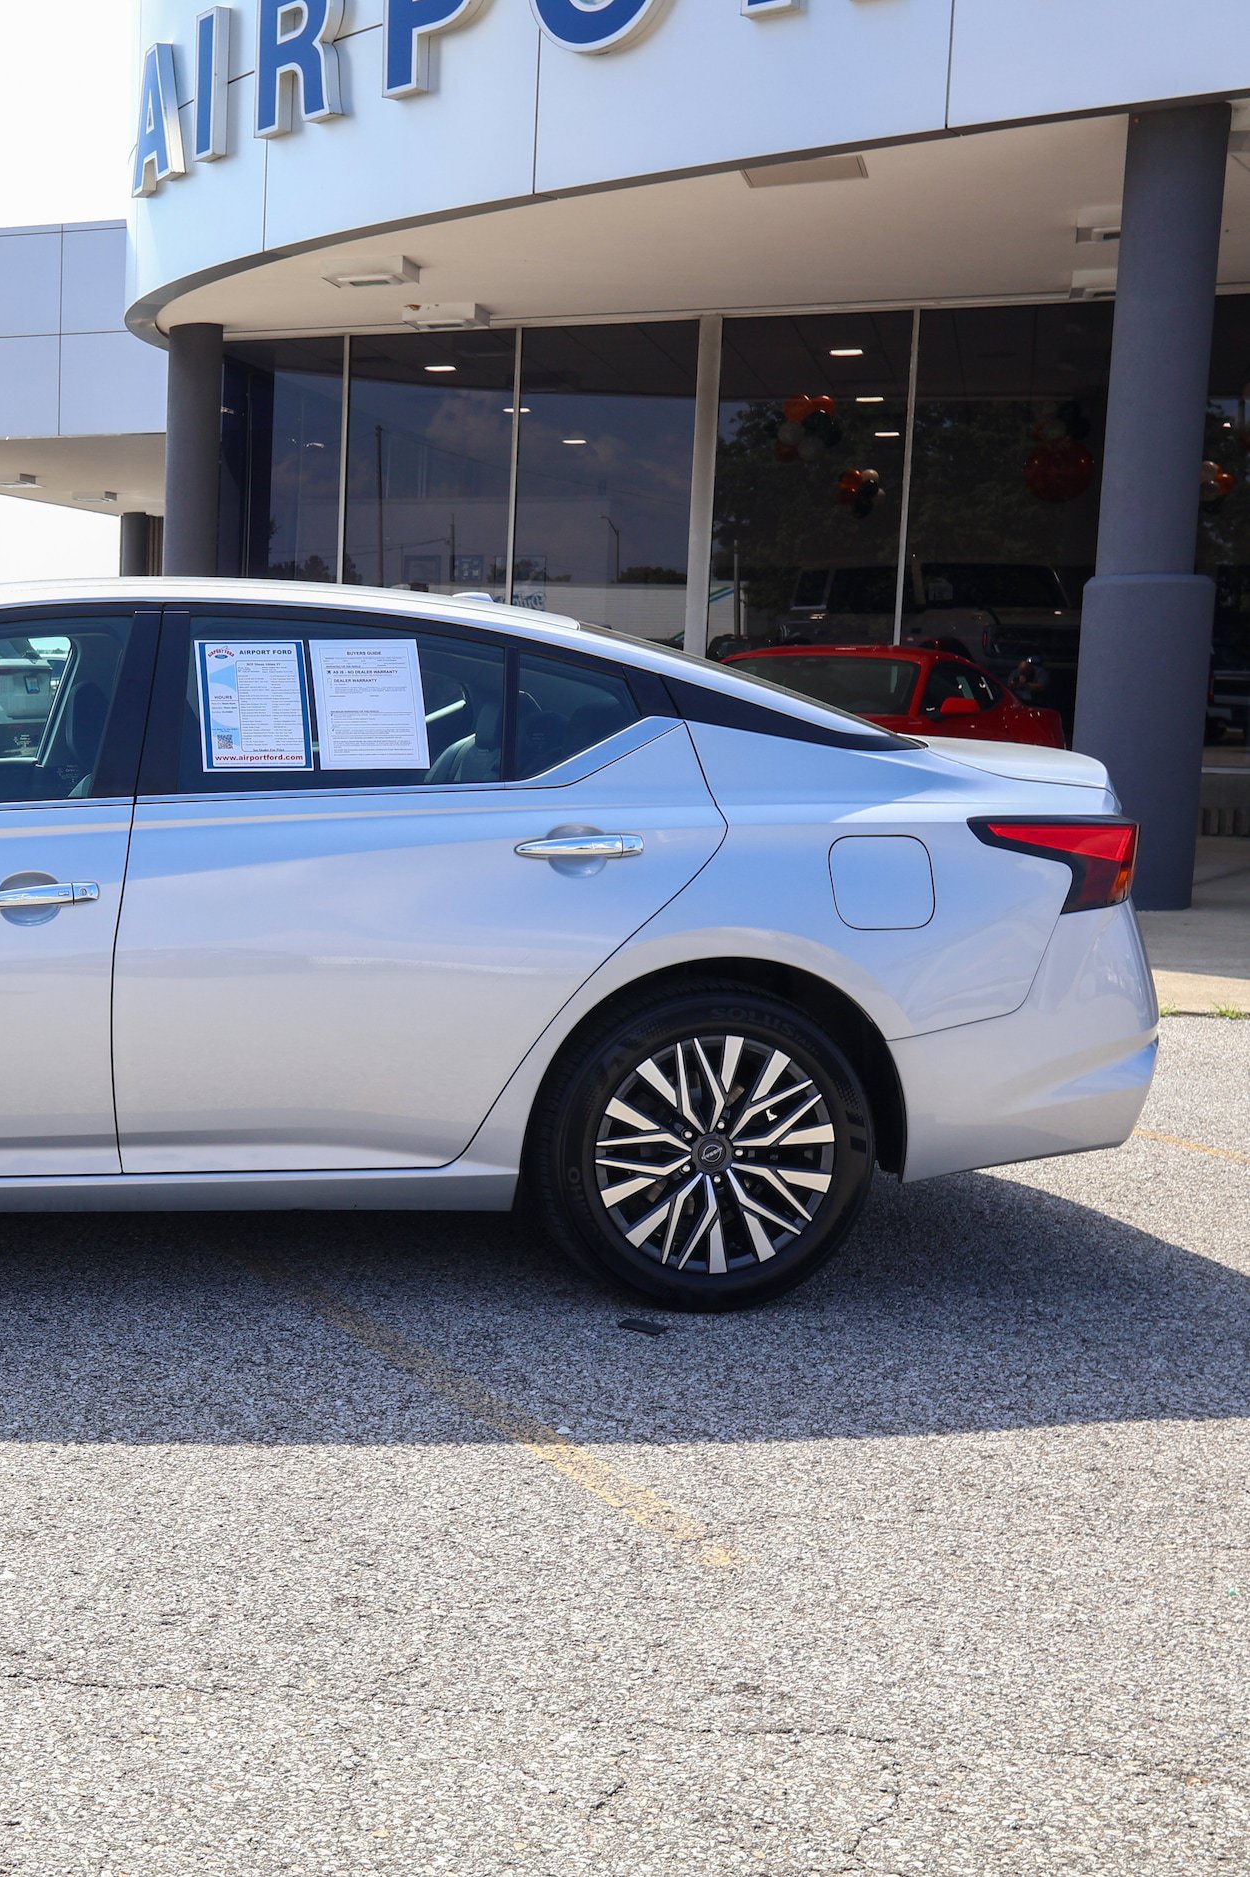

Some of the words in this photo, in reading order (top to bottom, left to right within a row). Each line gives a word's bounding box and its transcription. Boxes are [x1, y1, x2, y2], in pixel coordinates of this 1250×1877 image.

[131, 0, 802, 197] AIRP
[214, 754, 303, 762] www.airportford.com
[709, 1008, 795, 1036] SOLUS
